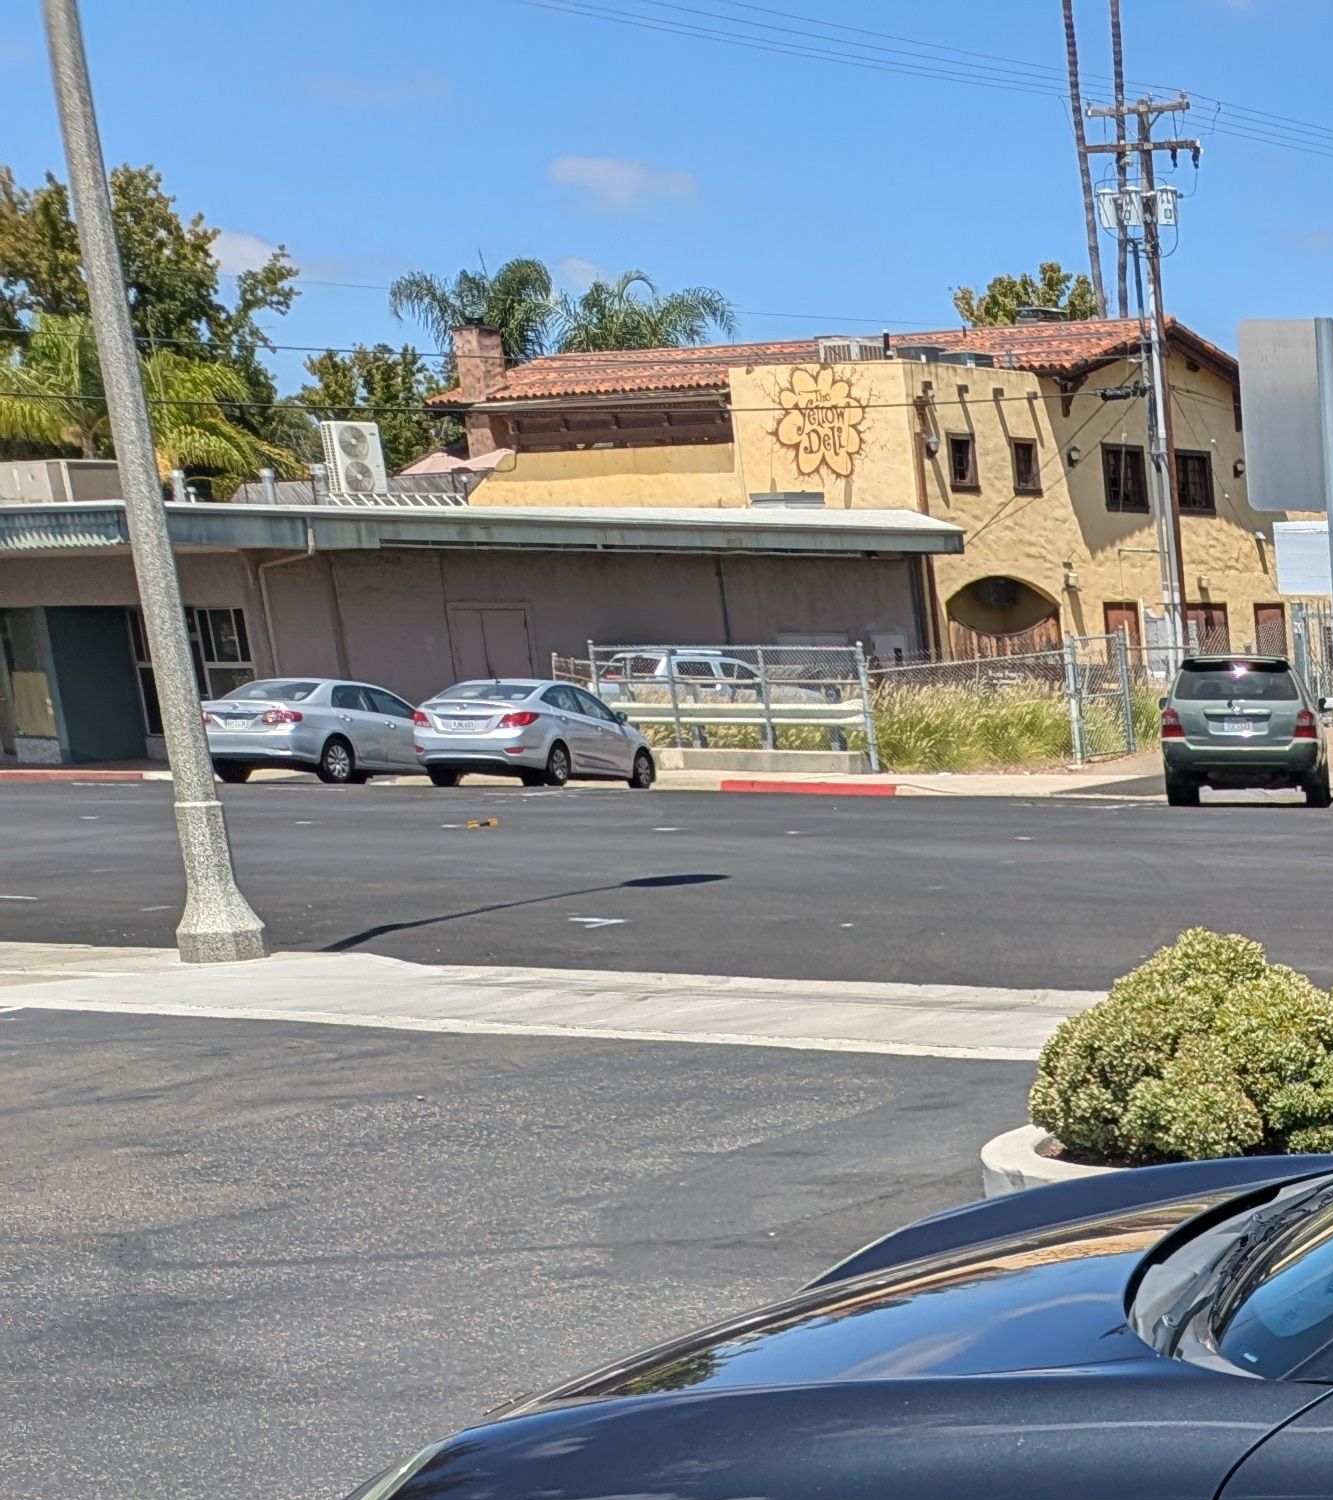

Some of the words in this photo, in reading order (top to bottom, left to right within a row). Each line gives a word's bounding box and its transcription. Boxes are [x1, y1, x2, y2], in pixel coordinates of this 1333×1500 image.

[800, 390, 832, 402] The
[796, 399, 850, 436] Yellow
[803, 426, 846, 456] Deli
